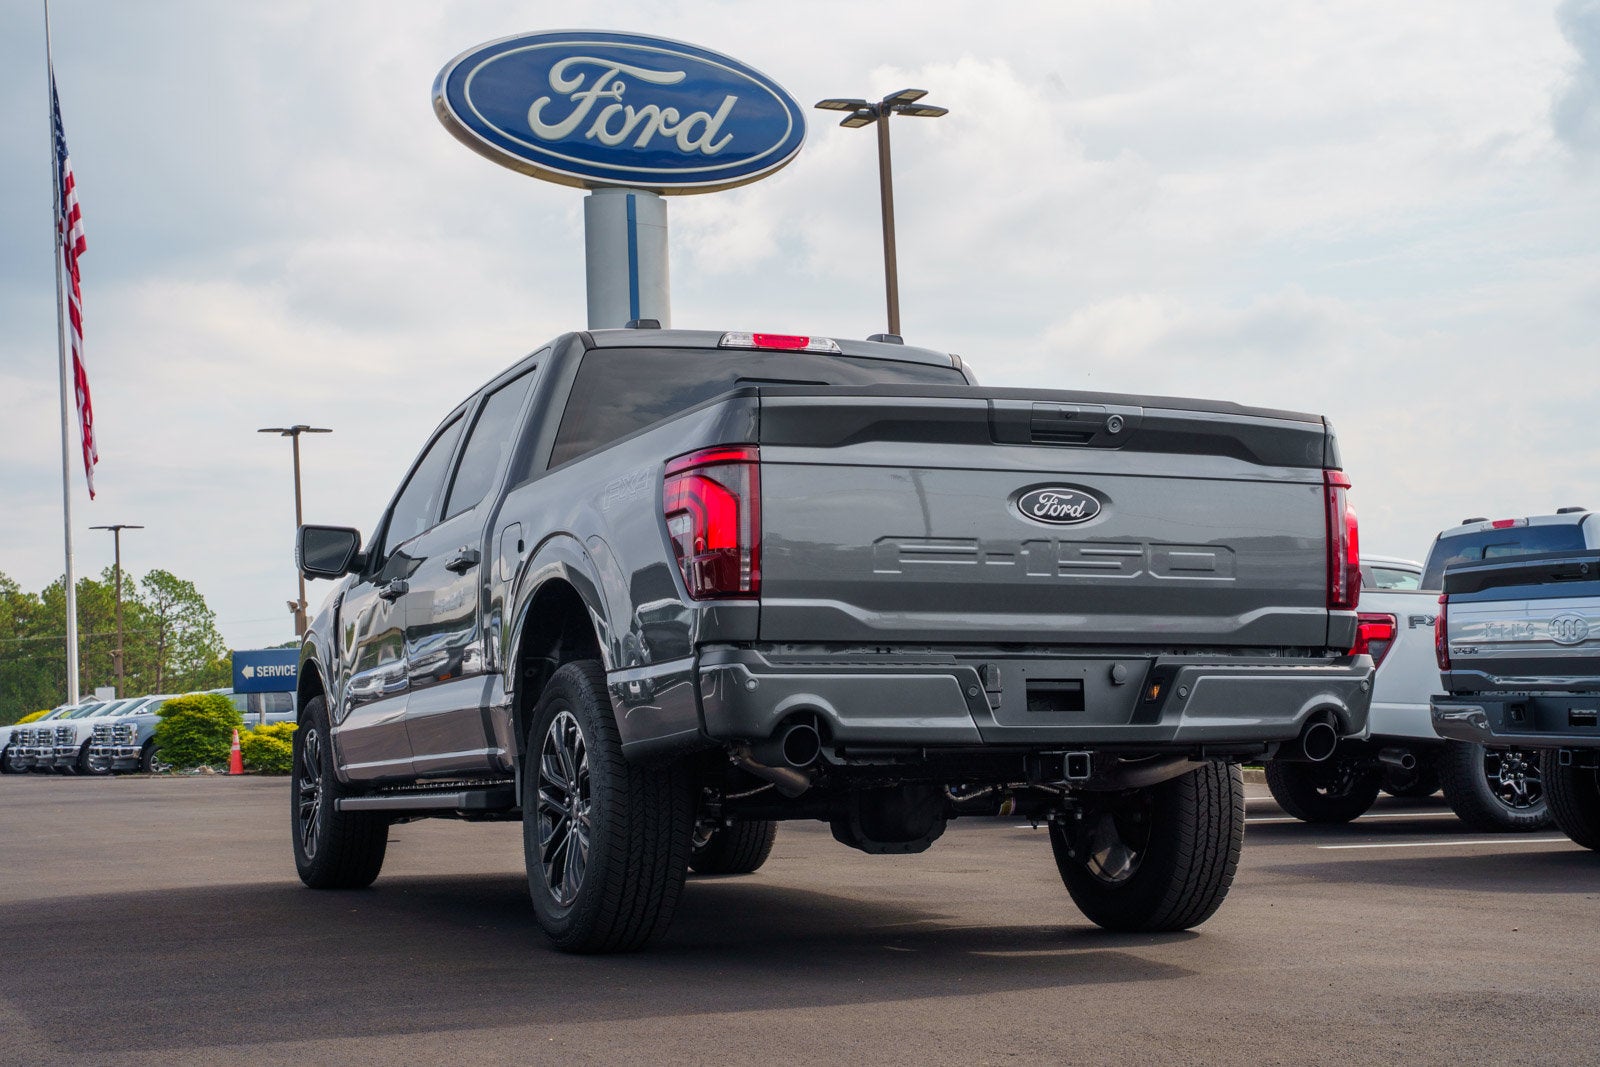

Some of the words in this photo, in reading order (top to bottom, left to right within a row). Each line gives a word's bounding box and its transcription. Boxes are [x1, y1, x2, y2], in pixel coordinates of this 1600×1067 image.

[527, 56, 738, 155] Ford
[1033, 492, 1086, 519] Ford
[873, 535, 1236, 581] F-150
[1485, 622, 1535, 639] KING
[256, 665, 297, 678] SERVICE
